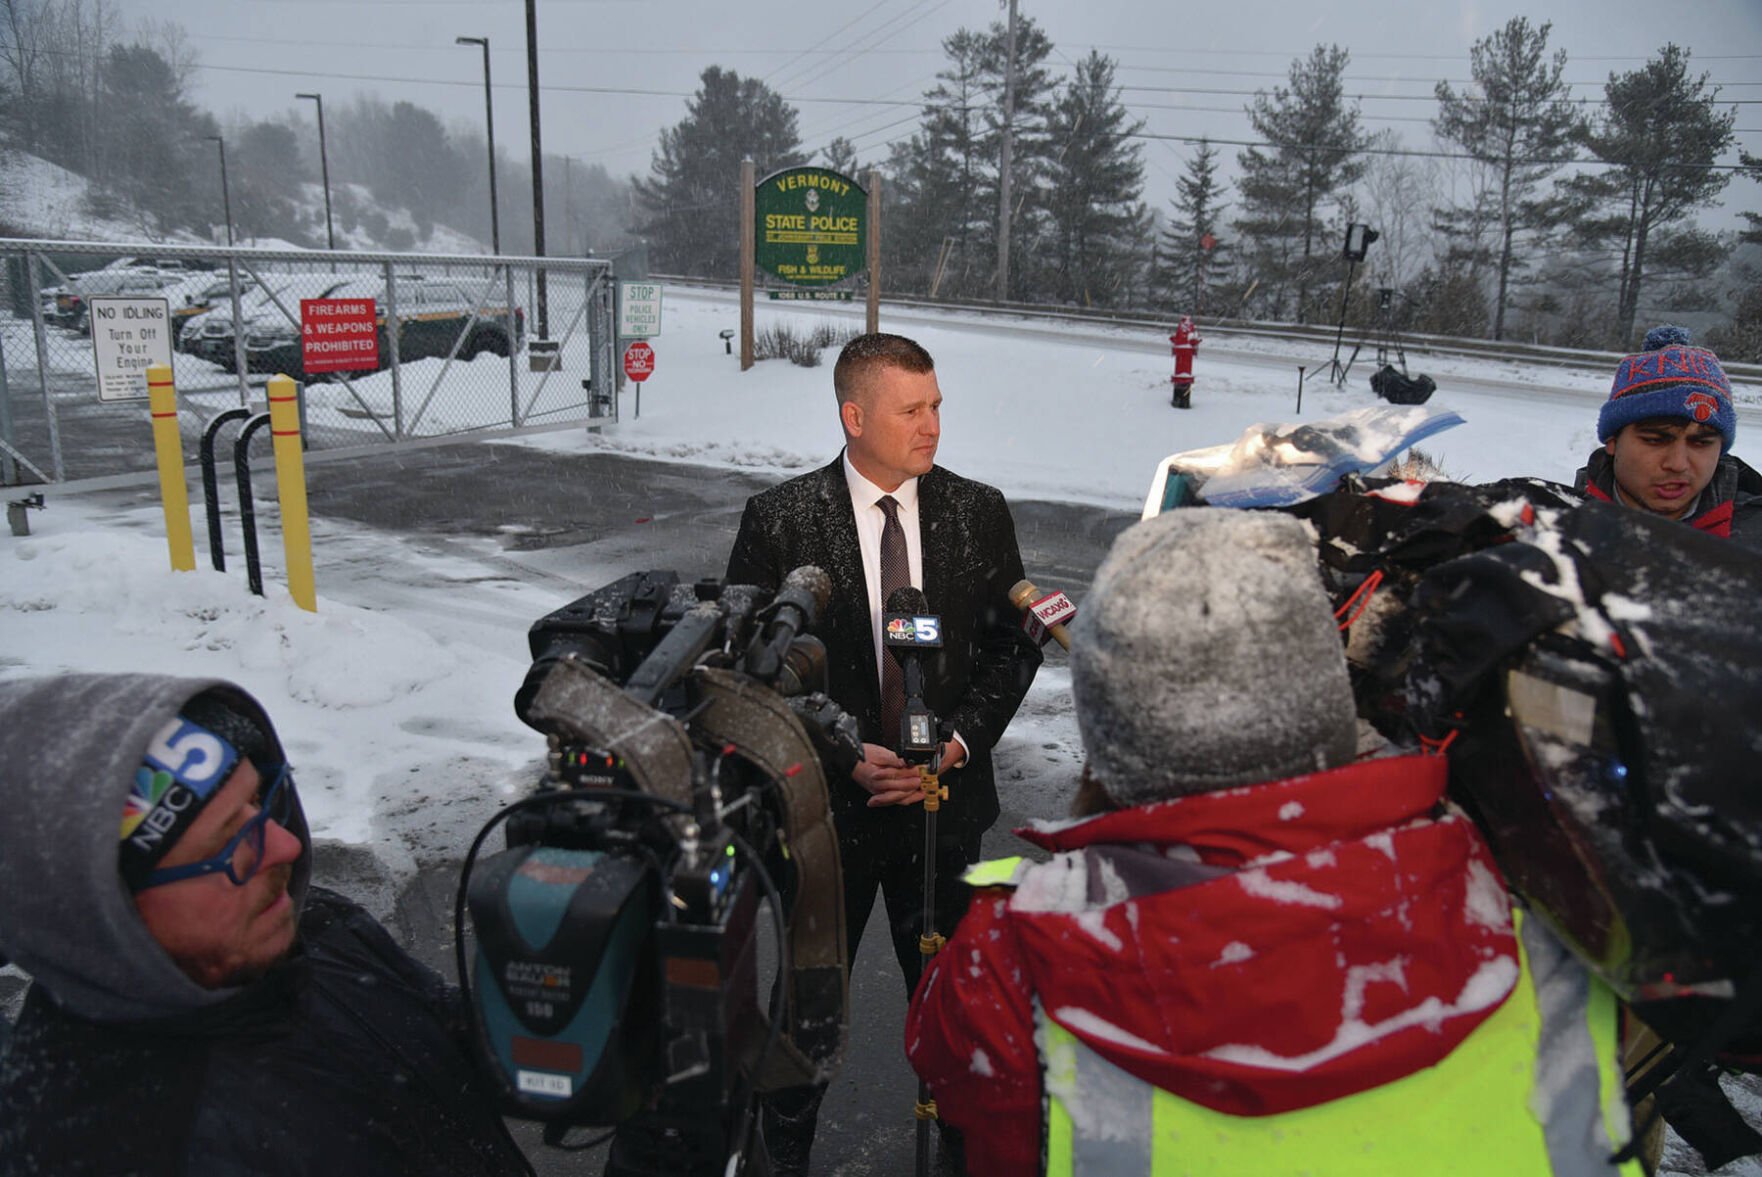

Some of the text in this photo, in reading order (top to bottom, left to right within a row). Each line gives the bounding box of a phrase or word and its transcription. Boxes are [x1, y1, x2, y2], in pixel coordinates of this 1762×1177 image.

[777, 174, 850, 197] VERMONT
[766, 214, 859, 232] STATE POLICE
[778, 264, 798, 274] FISH
[809, 265, 847, 275] WILDLIFE
[630, 287, 654, 299] STOP
[97, 305, 164, 320] NO IDLING
[308, 303, 367, 316] FIREARMS
[629, 303, 653, 314] POLICE
[109, 327, 157, 341] Turn Off
[304, 322, 373, 334] & WEAPONS
[118, 342, 148, 355] Your
[305, 340, 374, 353] PROHIBITED
[628, 349, 651, 360] STOP
[117, 356, 153, 371] Engine
[632, 360, 646, 369] NO
[889, 619, 938, 641] NBC 5
[148, 715, 225, 782] 5
[131, 785, 193, 852] NBC
